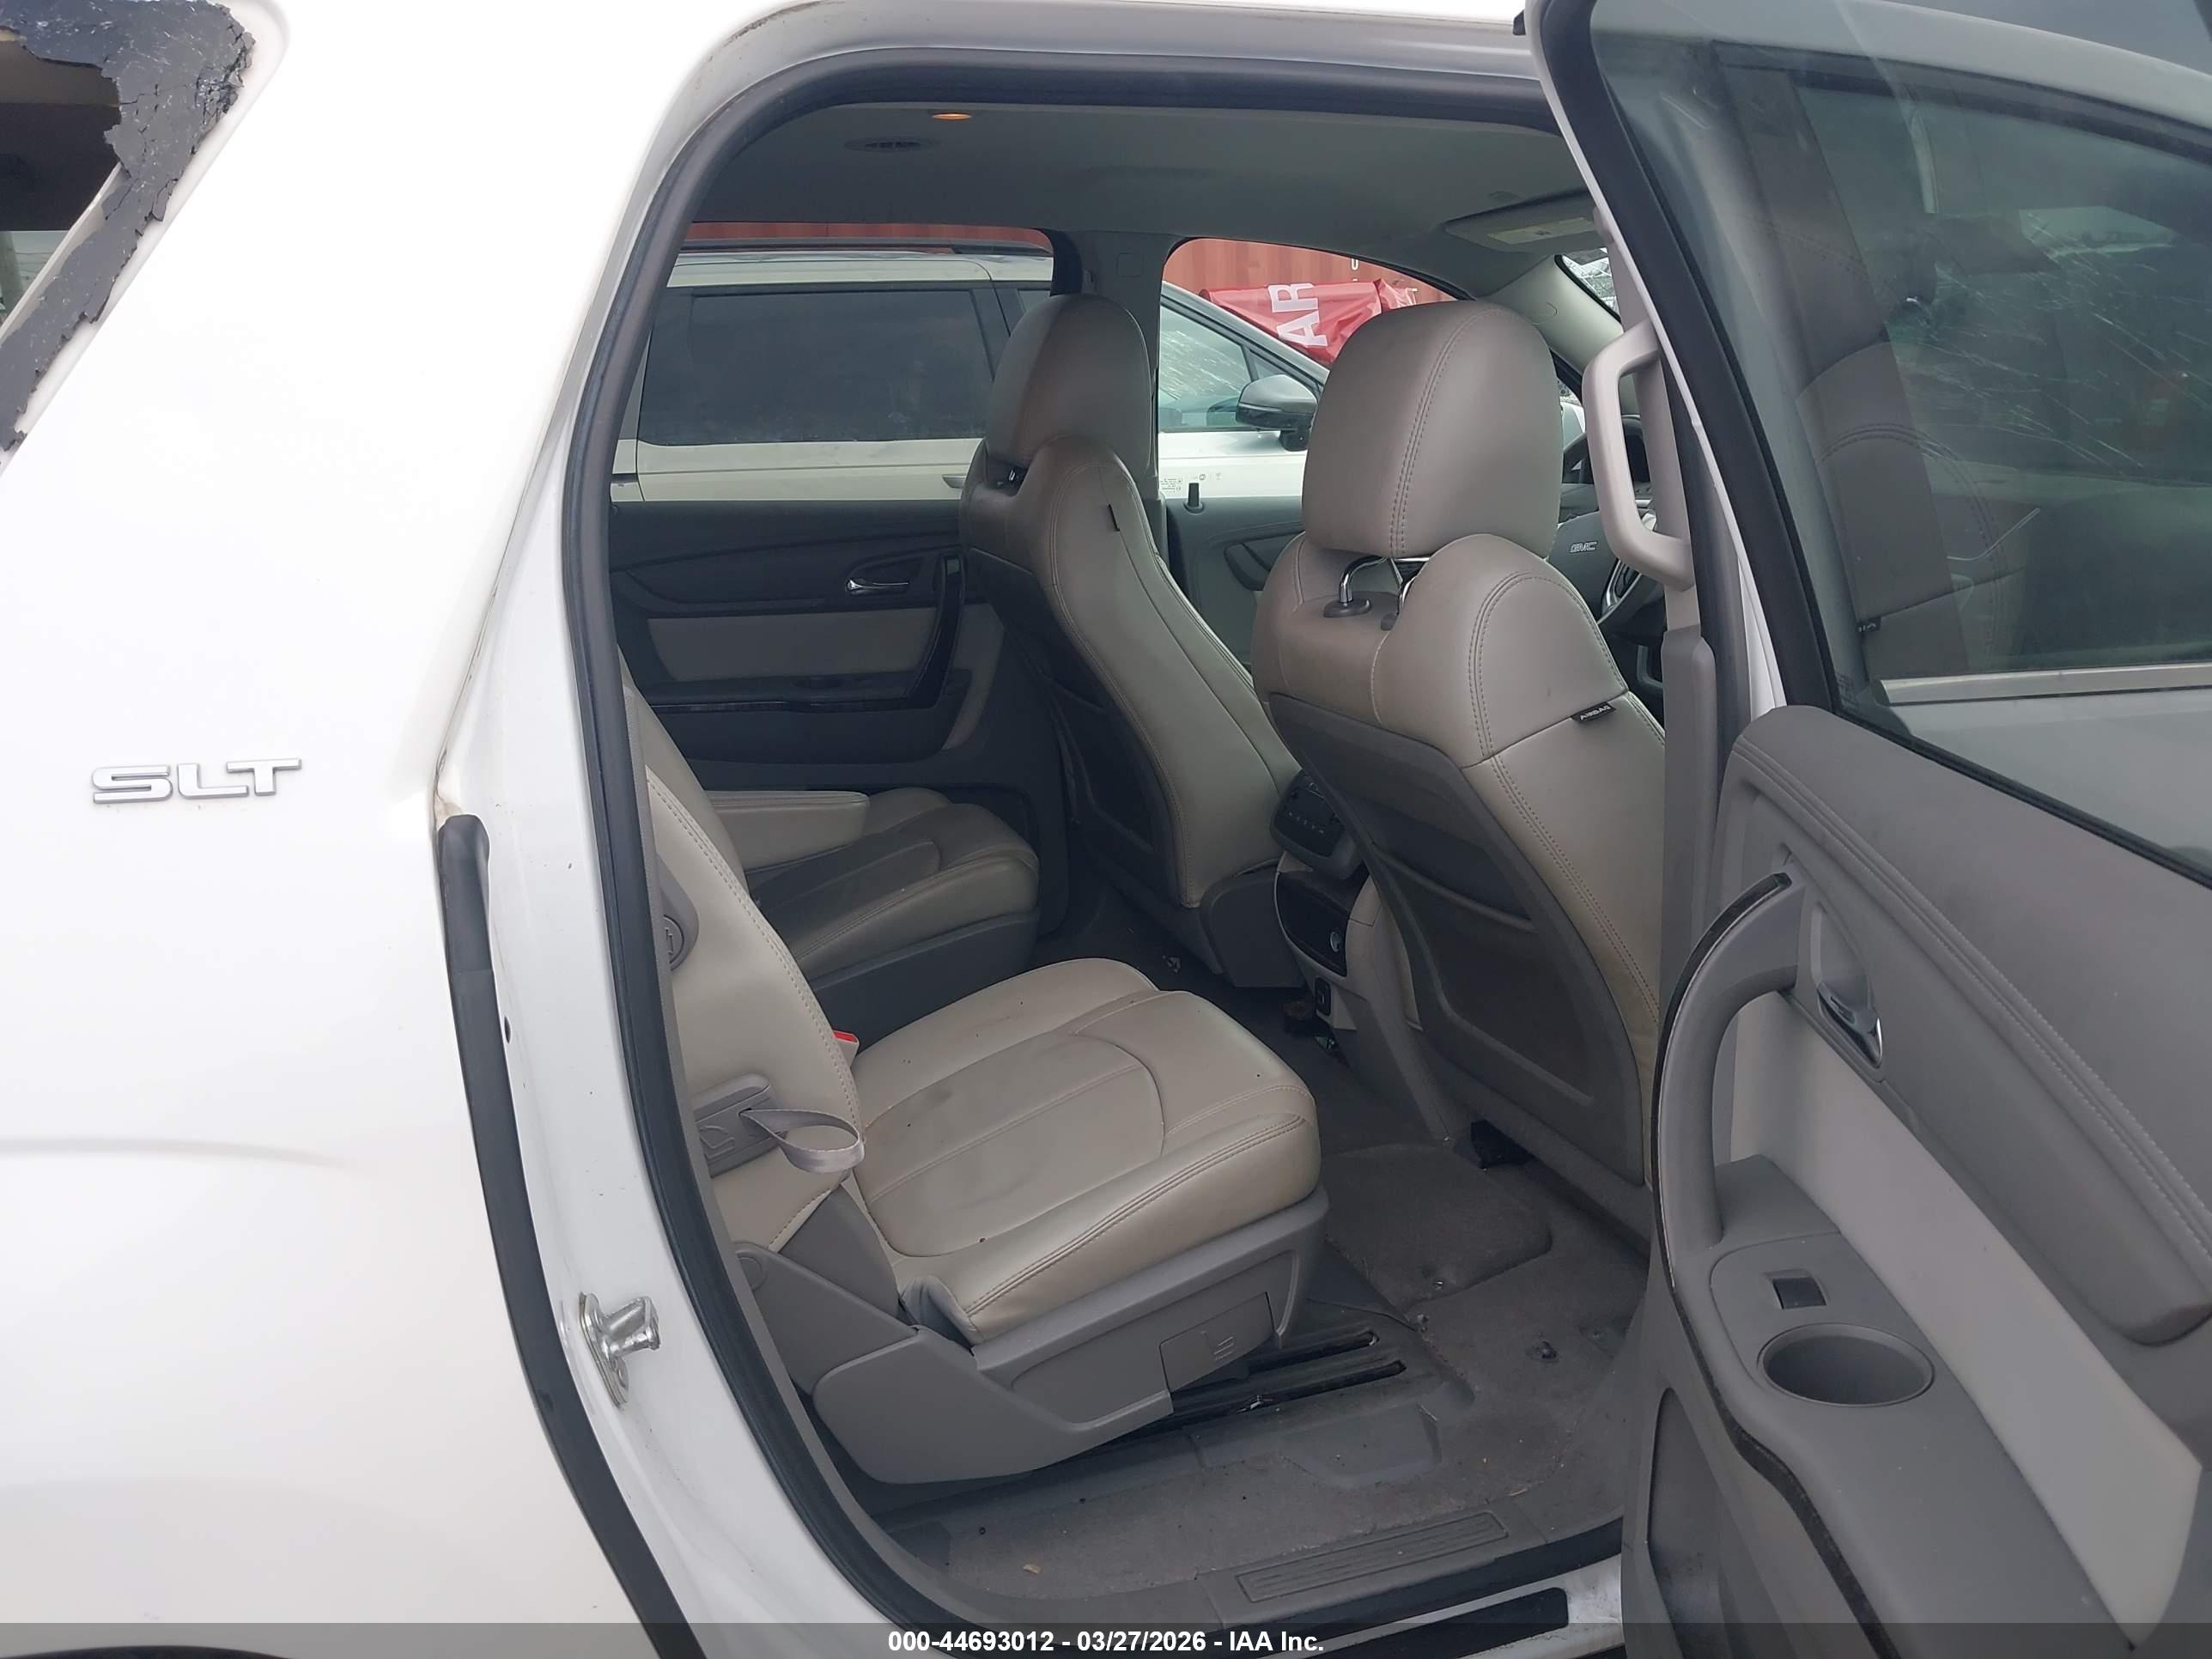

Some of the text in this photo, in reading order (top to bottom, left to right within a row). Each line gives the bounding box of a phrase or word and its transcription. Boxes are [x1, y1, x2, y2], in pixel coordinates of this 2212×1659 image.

[1267, 282, 1328, 347] AR
[1570, 541, 1597, 553] GMC
[1579, 704, 1612, 721] AIRBAG
[92, 757, 301, 804] SLT
